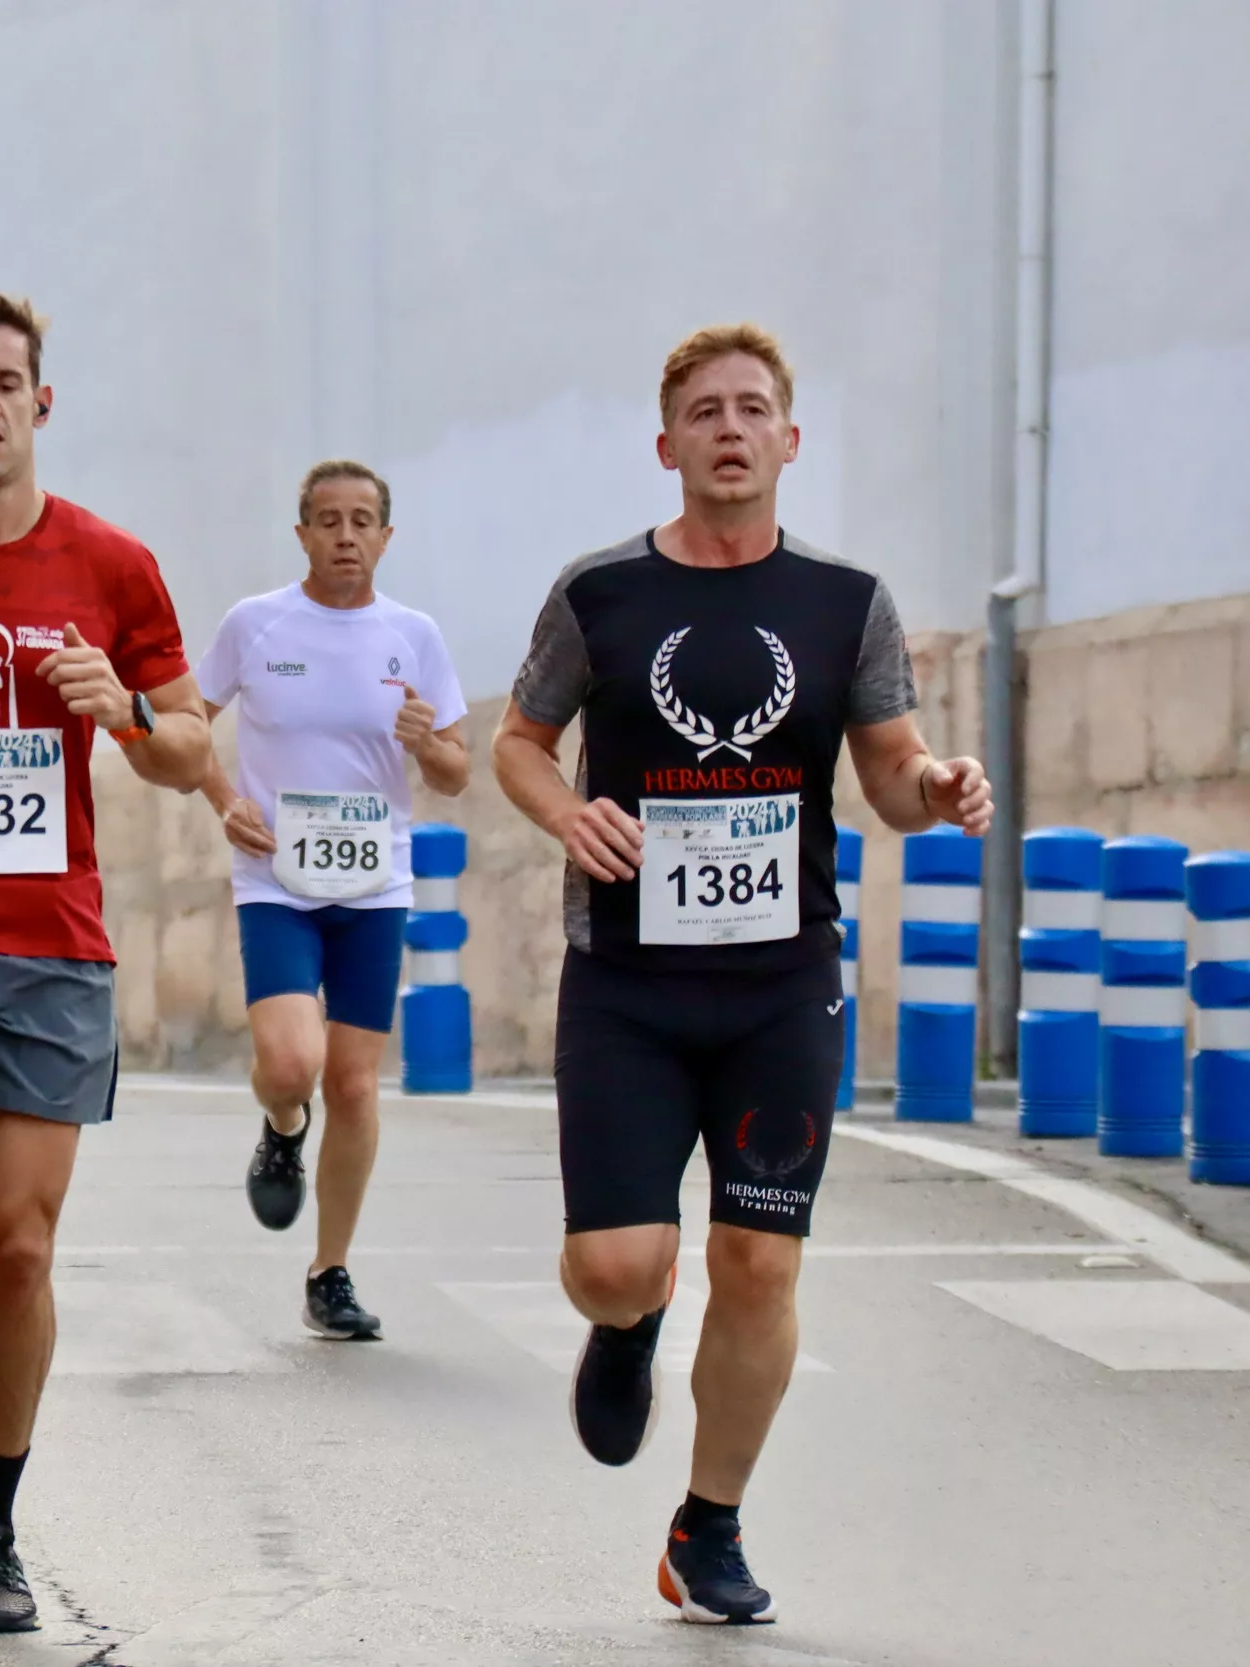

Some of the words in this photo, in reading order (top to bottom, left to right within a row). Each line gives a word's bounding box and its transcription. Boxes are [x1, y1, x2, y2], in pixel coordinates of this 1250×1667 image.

[644, 768, 746, 792] HERMES
[750, 767, 803, 790] GYM
[730, 802, 767, 820] 2024
[292, 838, 379, 871] 1398
[667, 858, 783, 907] 1384
[726, 1182, 781, 1201] HERMES
[783, 1189, 810, 1204] GYM
[739, 1198, 796, 1216] Training
